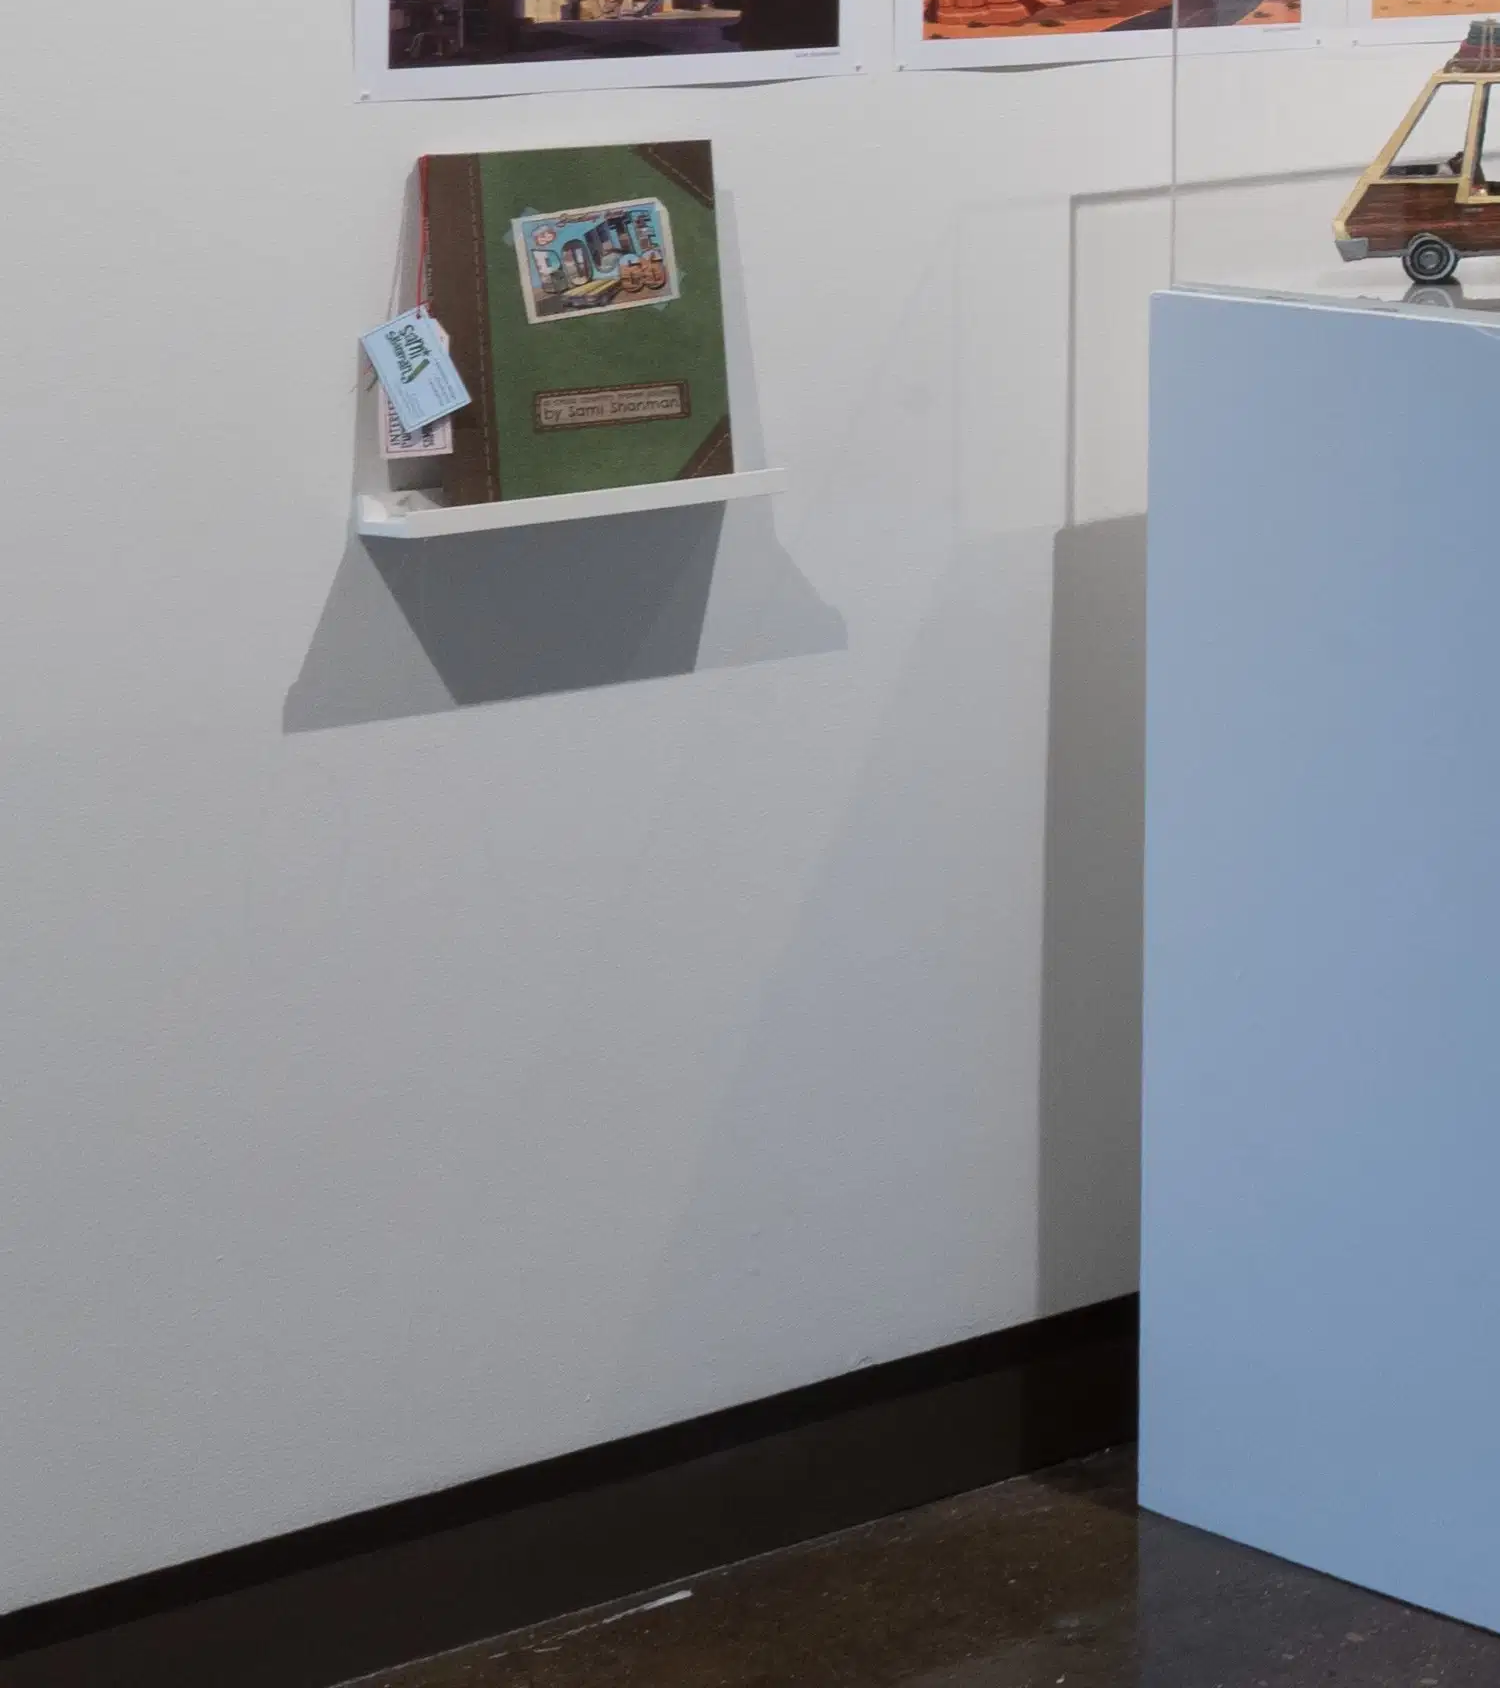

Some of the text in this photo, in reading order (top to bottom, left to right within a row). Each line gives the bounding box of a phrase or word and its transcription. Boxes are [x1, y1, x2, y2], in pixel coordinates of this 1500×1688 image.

[531, 210, 666, 294] ROUTE 66
[543, 398, 680, 422] by Sami Shanman
